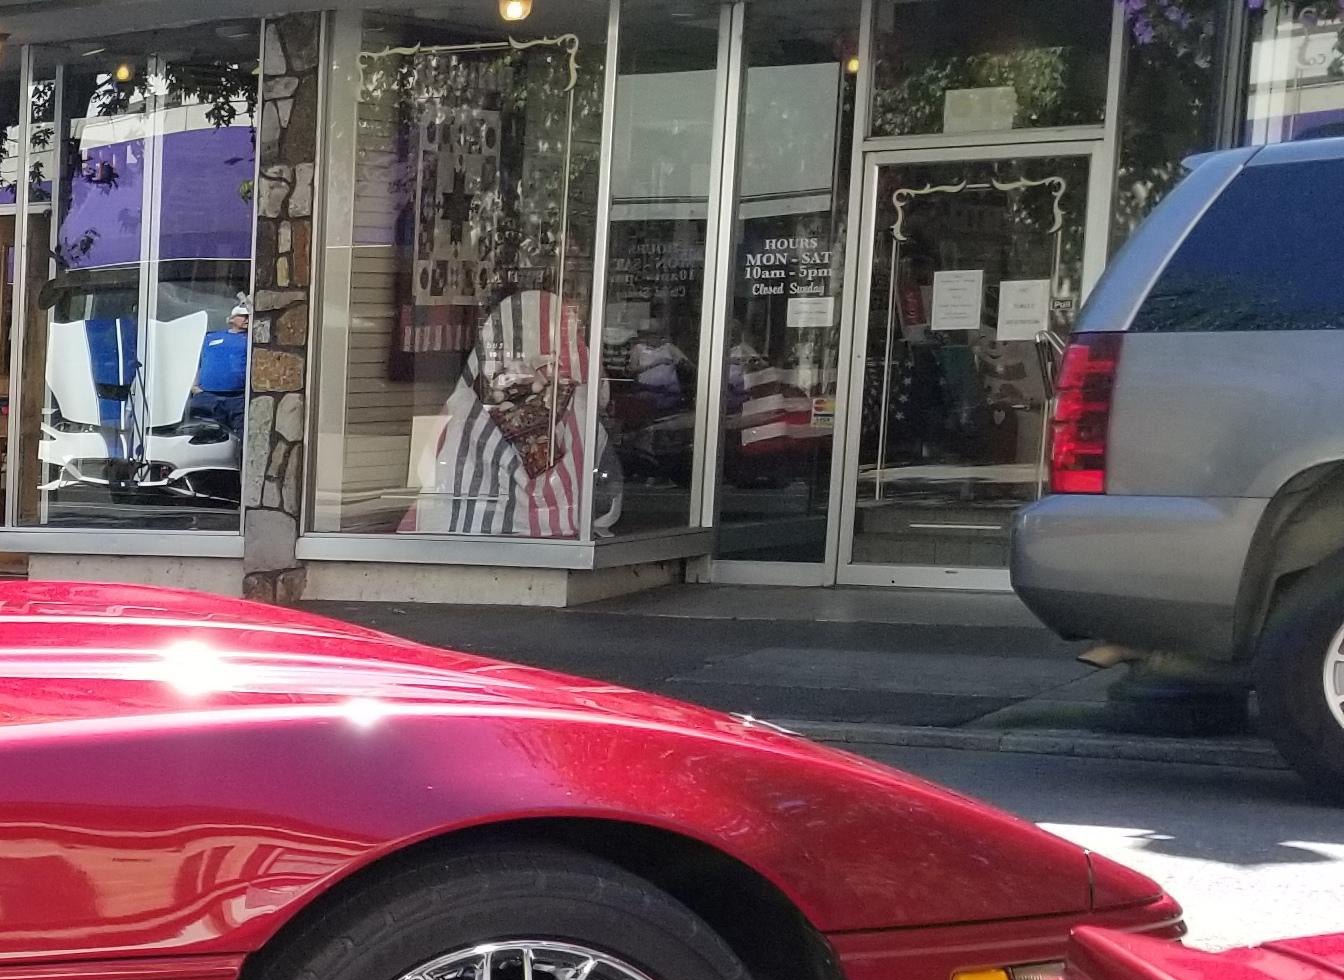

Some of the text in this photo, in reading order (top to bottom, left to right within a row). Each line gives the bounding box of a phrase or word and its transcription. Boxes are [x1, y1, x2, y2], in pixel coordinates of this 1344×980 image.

[764, 237, 819, 250] HOURS
[745, 252, 788, 266] MON
[801, 251, 832, 264] SAT
[744, 266, 787, 279] 10am
[798, 265, 833, 281] 5pm
[752, 282, 825, 297] Closed Sunday
